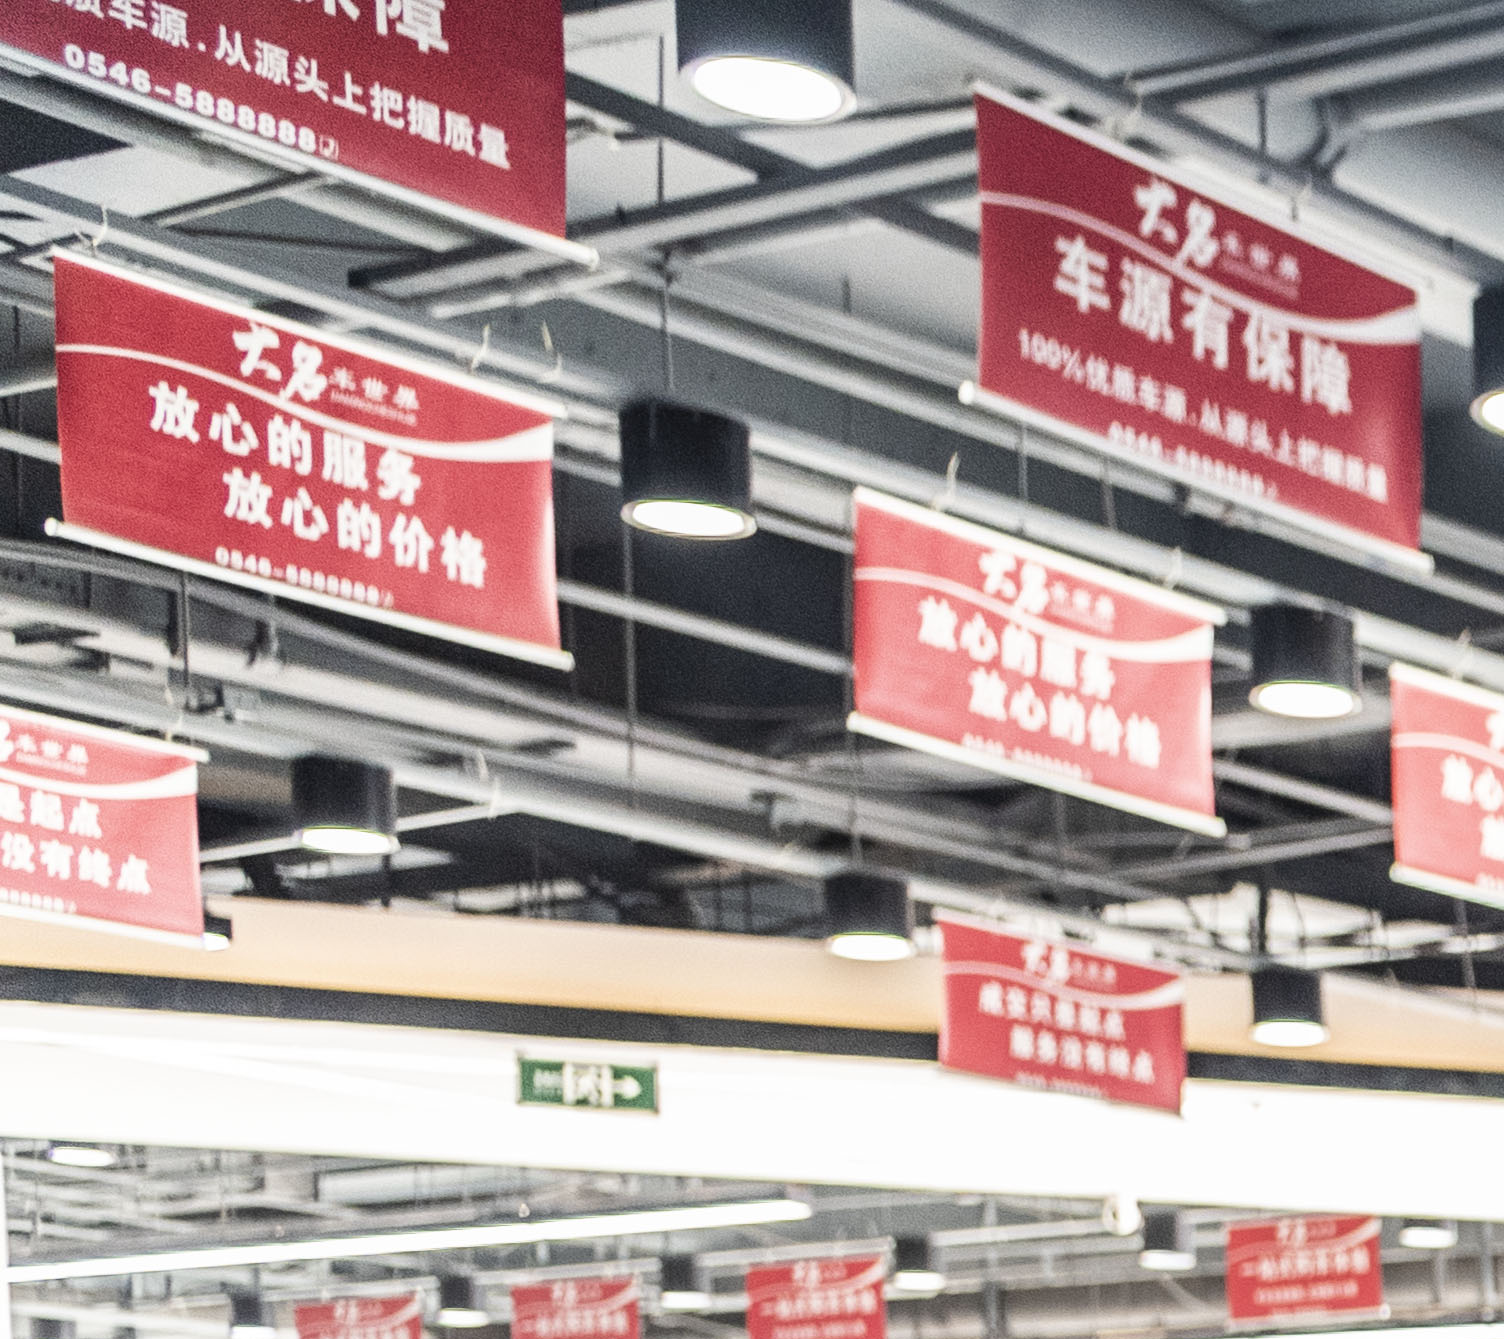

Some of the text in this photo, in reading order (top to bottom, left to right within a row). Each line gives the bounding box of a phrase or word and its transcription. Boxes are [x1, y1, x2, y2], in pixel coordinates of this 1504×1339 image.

[1054, 234, 1353, 415] 车源有保障
[149, 380, 422, 506] 放心的服务
[222, 465, 487, 590] 放心的价格
